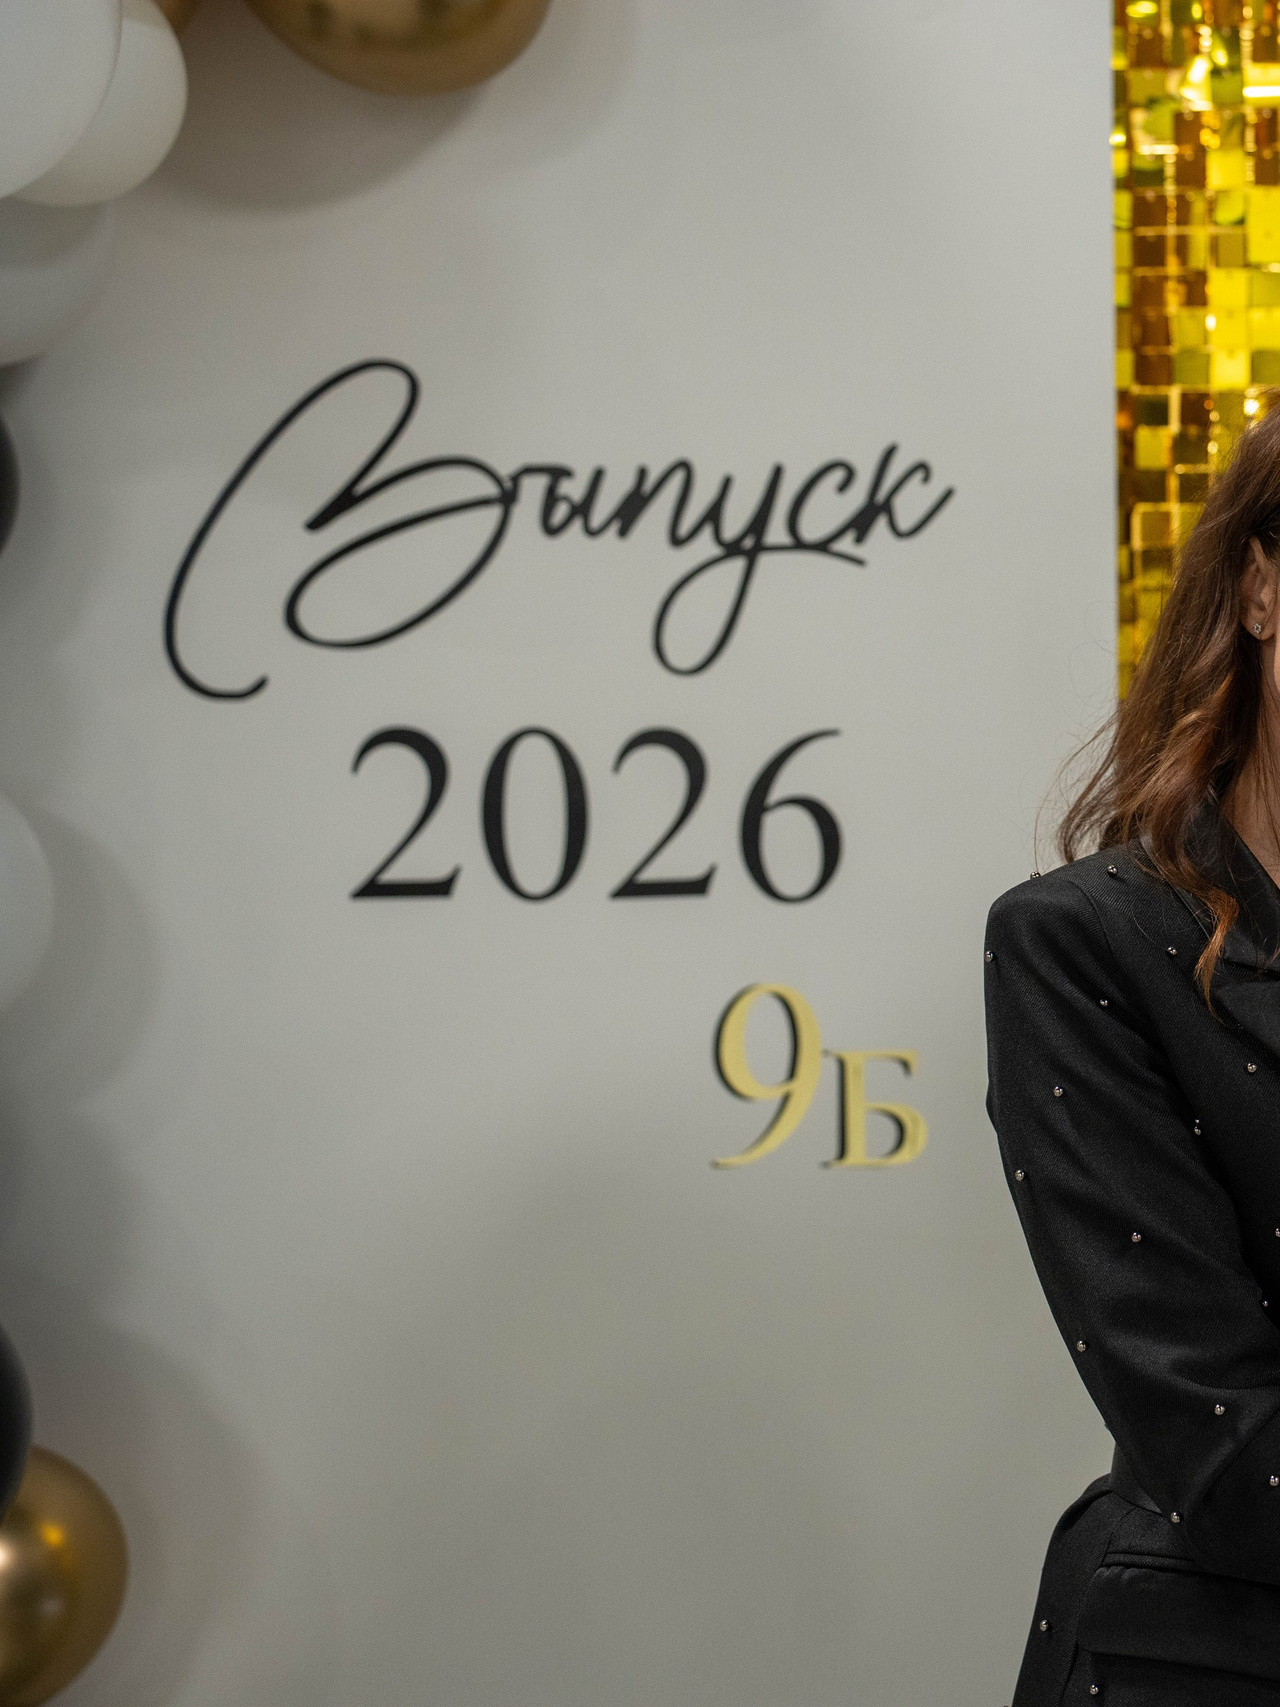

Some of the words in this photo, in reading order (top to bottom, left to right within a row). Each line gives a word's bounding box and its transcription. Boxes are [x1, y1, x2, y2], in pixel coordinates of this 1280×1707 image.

[162, 358, 954, 701] Выпуск
[350, 726, 842, 904] 2026
[711, 982, 929, 1168] 9Б
